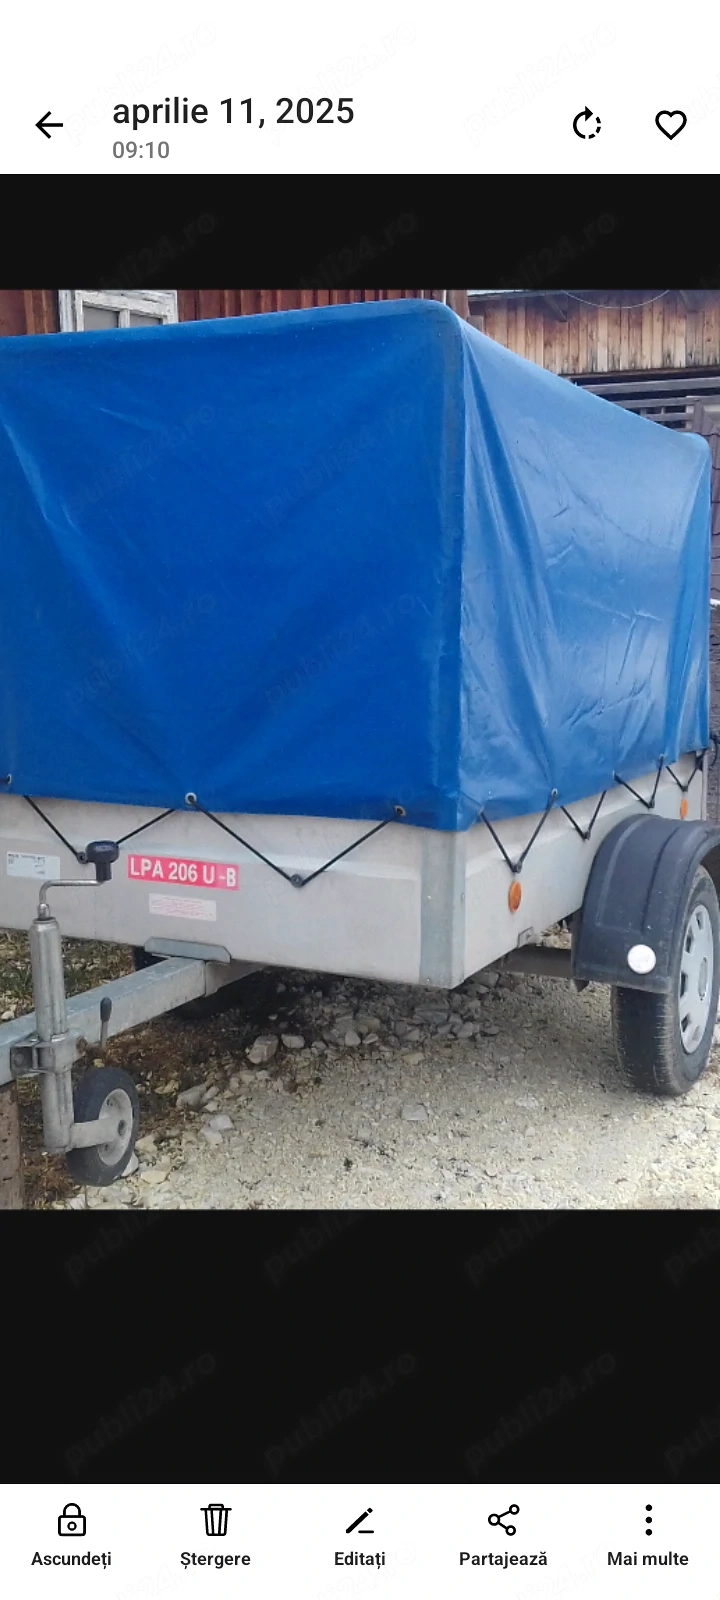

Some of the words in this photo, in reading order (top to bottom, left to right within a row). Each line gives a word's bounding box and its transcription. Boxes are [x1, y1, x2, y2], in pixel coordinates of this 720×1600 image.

[113, 97, 208, 131] aprilie
[220, 97, 265, 131] 11,
[275, 97, 355, 124] 2025
[112, 140, 170, 159] 09:10
[130, 857, 164, 878] LPA
[168, 862, 198, 882] 206
[203, 865, 215, 884] U
[459, 1550, 548, 1570] Partajează
[607, 1551, 638, 1566] Mai
[642, 1550, 689, 1566] multe
